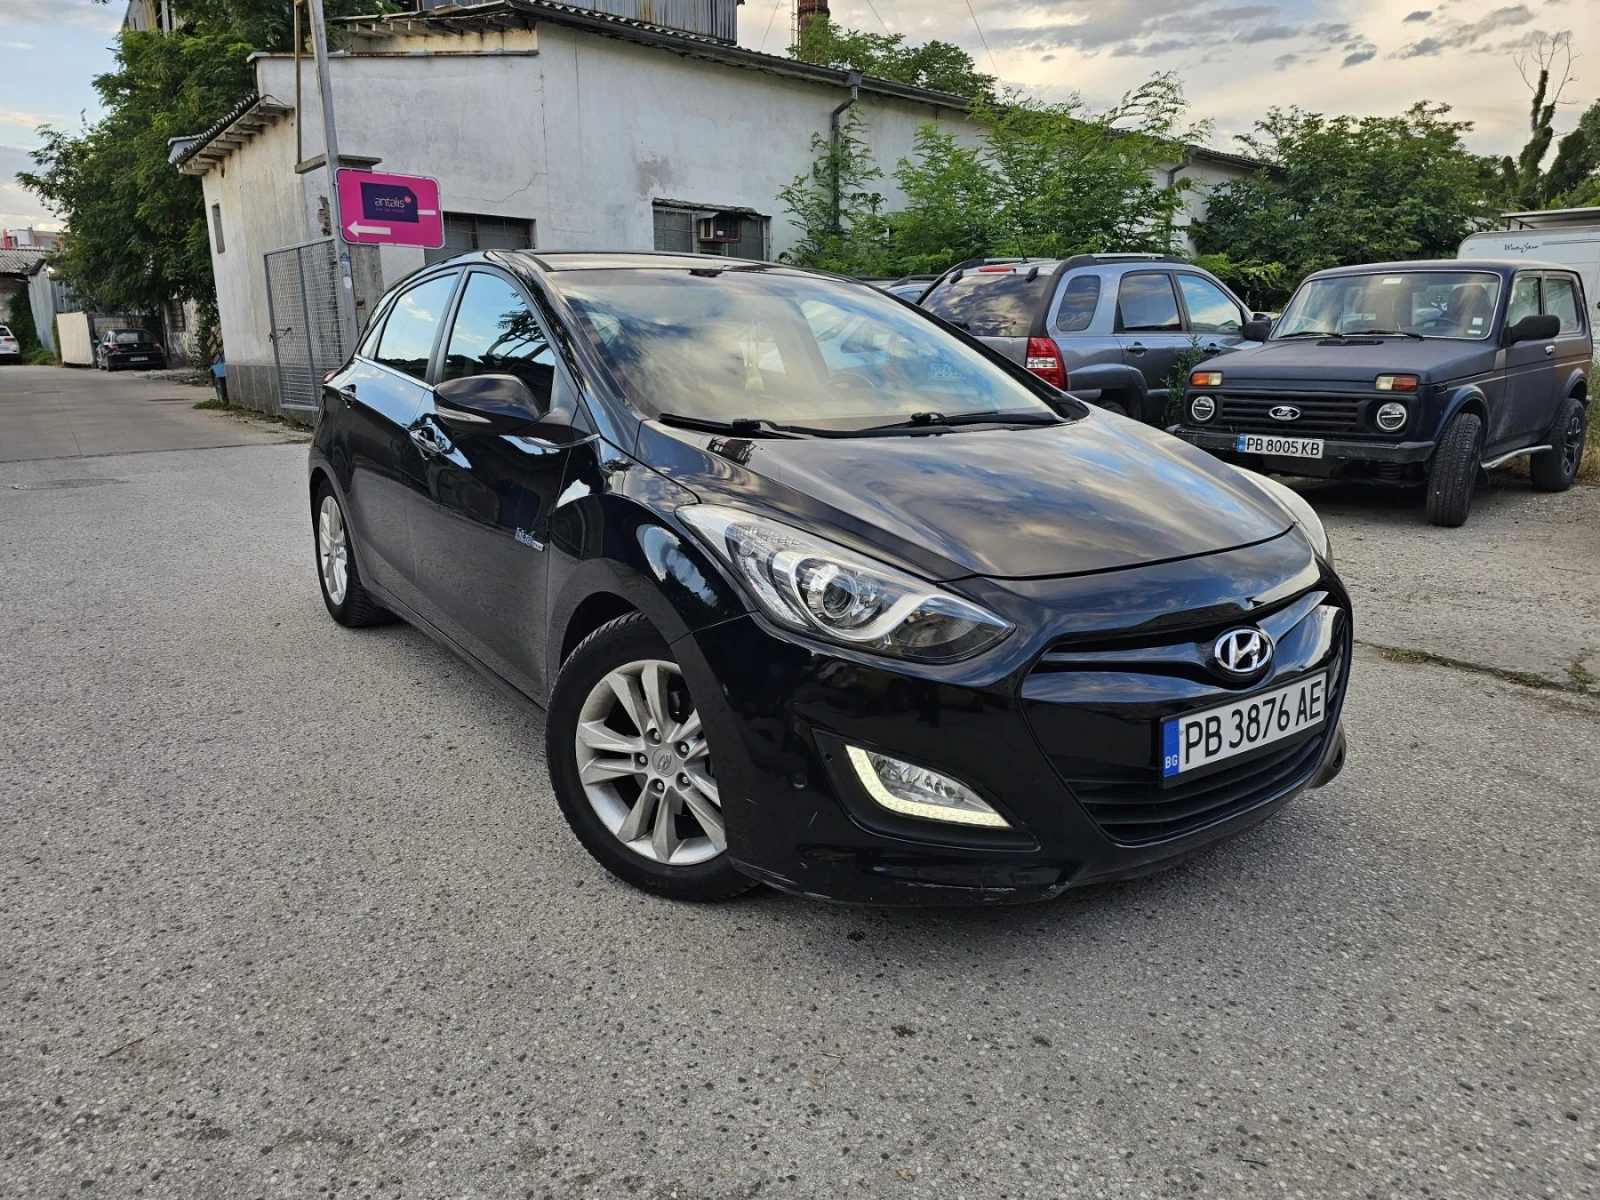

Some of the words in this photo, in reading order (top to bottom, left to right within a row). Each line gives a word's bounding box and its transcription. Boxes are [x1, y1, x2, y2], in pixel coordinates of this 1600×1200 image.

[374, 196, 405, 208] antalis
[1246, 437, 1263, 452] PB
[1265, 439, 1299, 454] 8005
[1301, 441, 1320, 456] KB
[1184, 715, 1223, 765] PB
[1228, 693, 1291, 749] 3876
[1295, 679, 1323, 727] AE
[1164, 754, 1179, 769] BG
